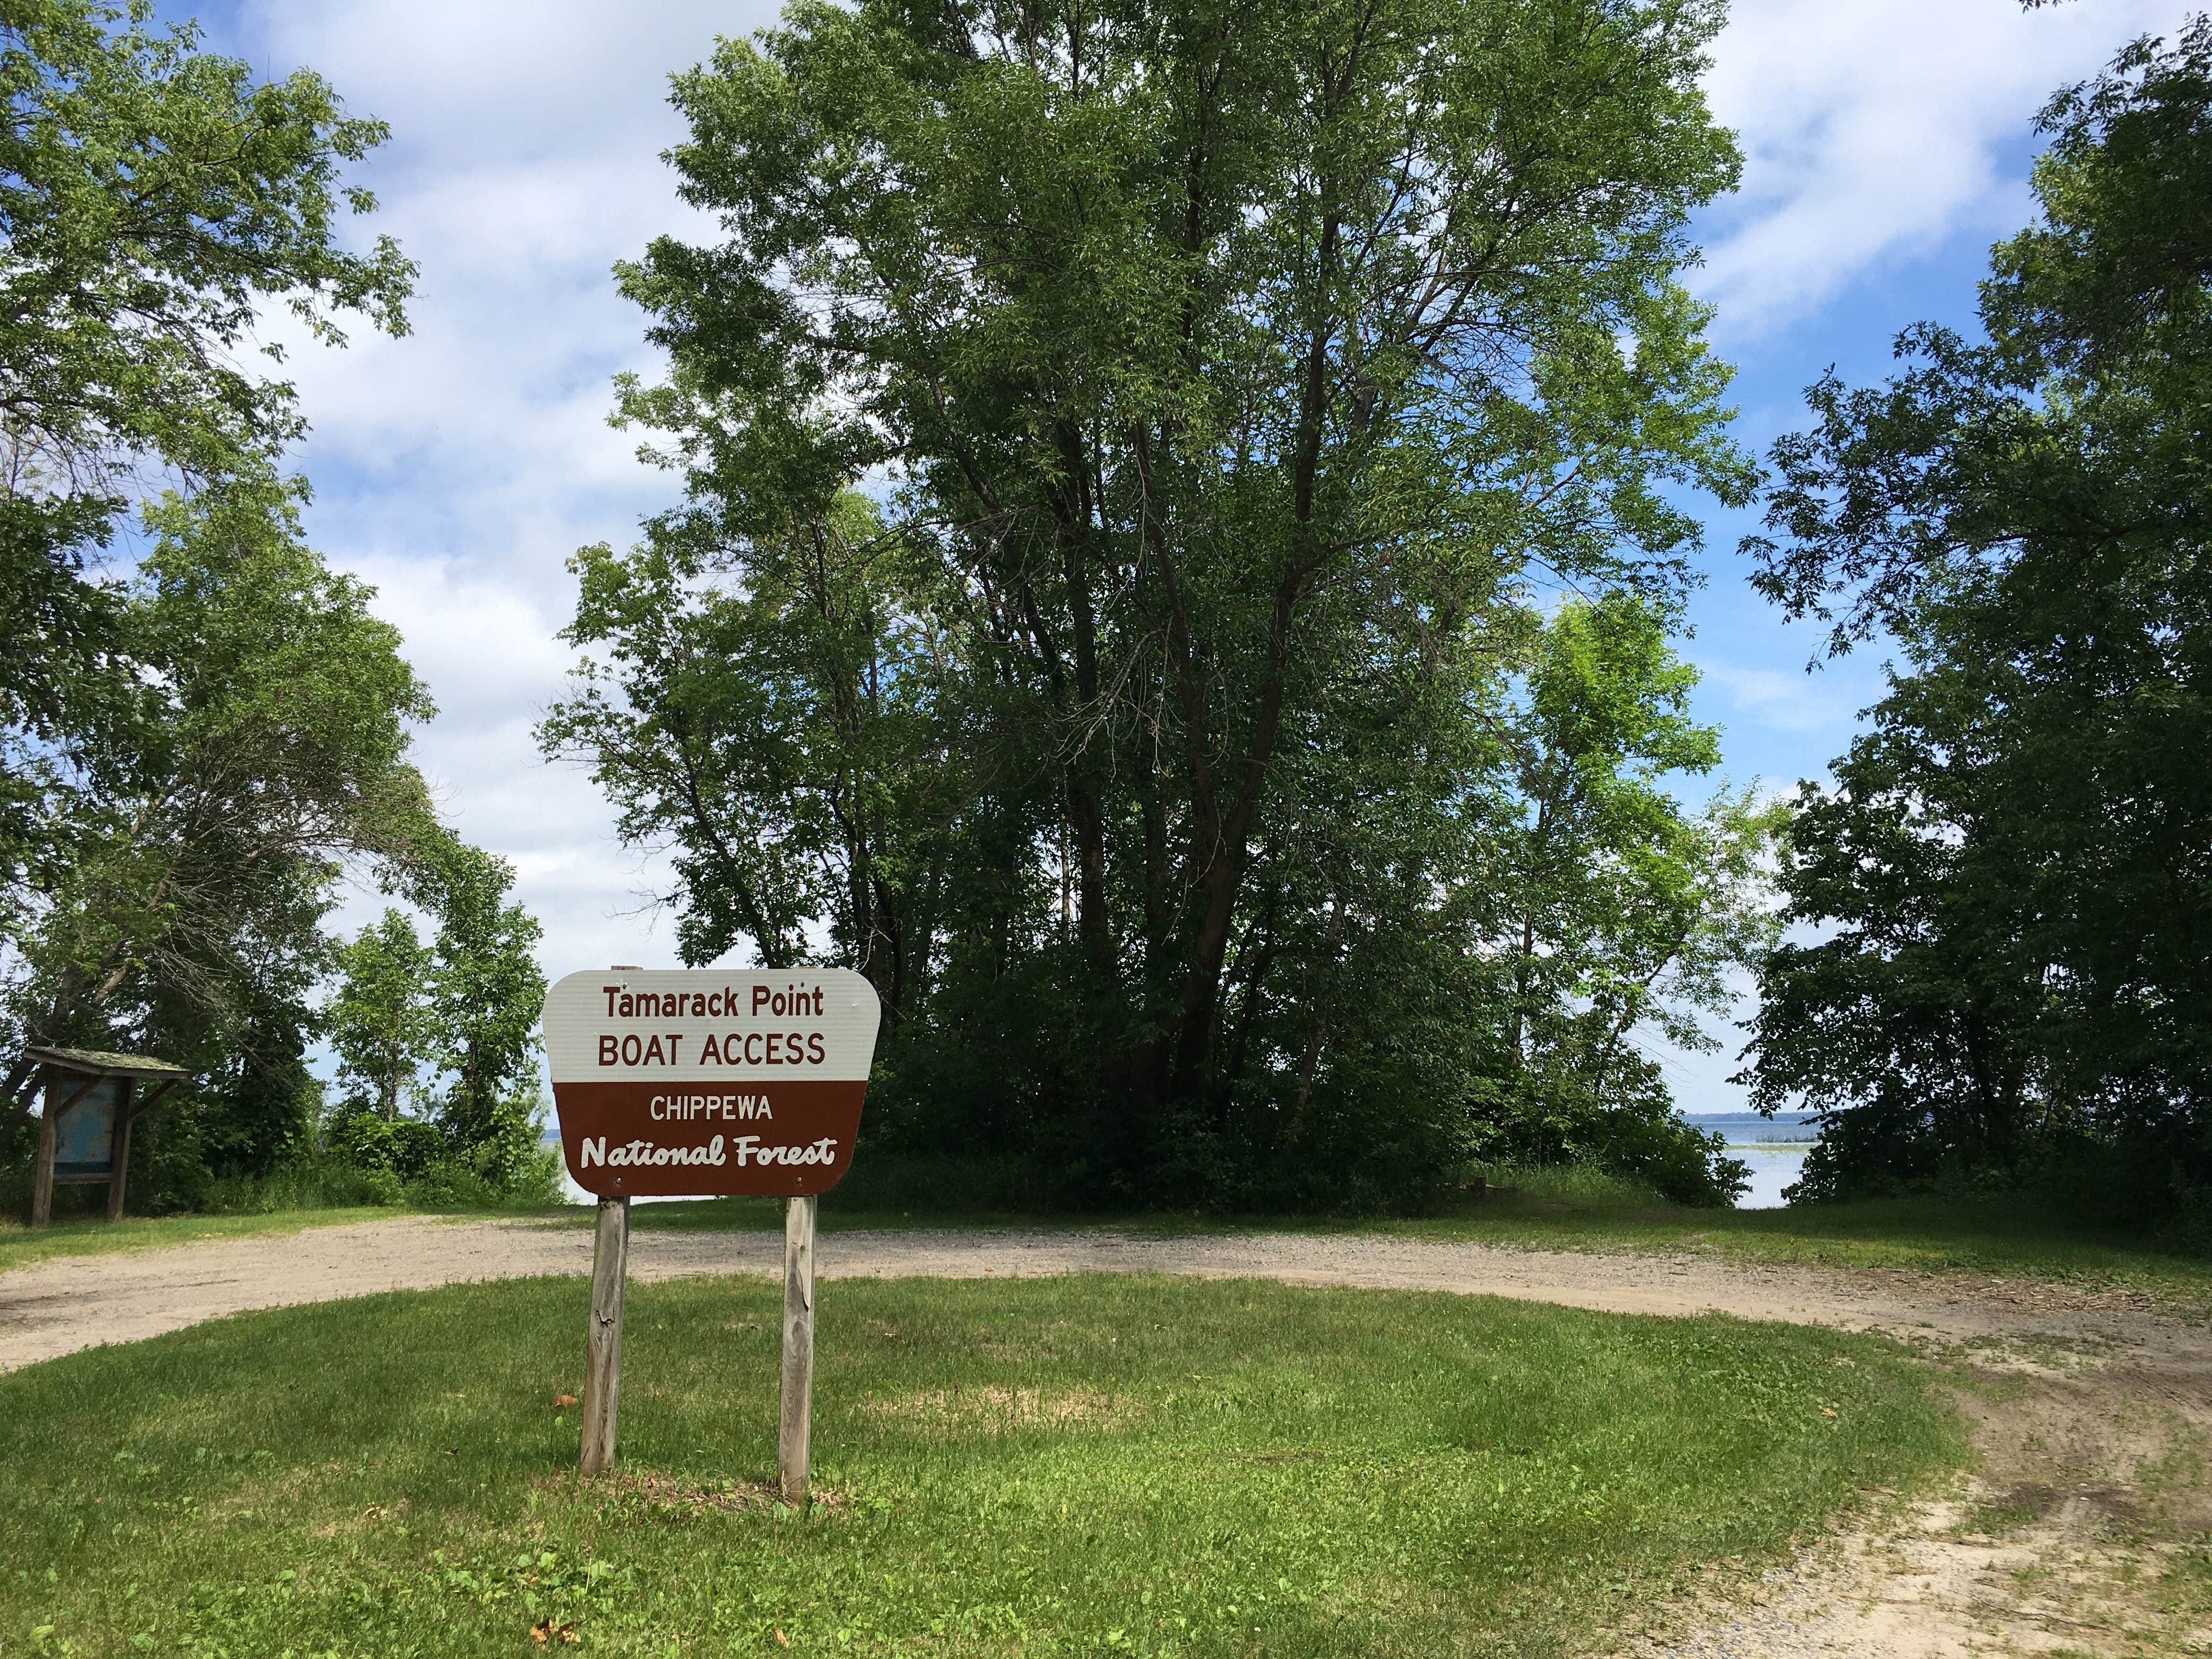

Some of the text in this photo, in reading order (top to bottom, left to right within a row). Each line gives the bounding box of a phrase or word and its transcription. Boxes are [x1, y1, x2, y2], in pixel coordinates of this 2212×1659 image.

[603, 984, 824, 1017] Tamarack Point
[599, 1032, 826, 1066] BOAT ACCESS
[650, 1095, 773, 1120] CHIPPEWA
[581, 1134, 838, 1169] National Forest
